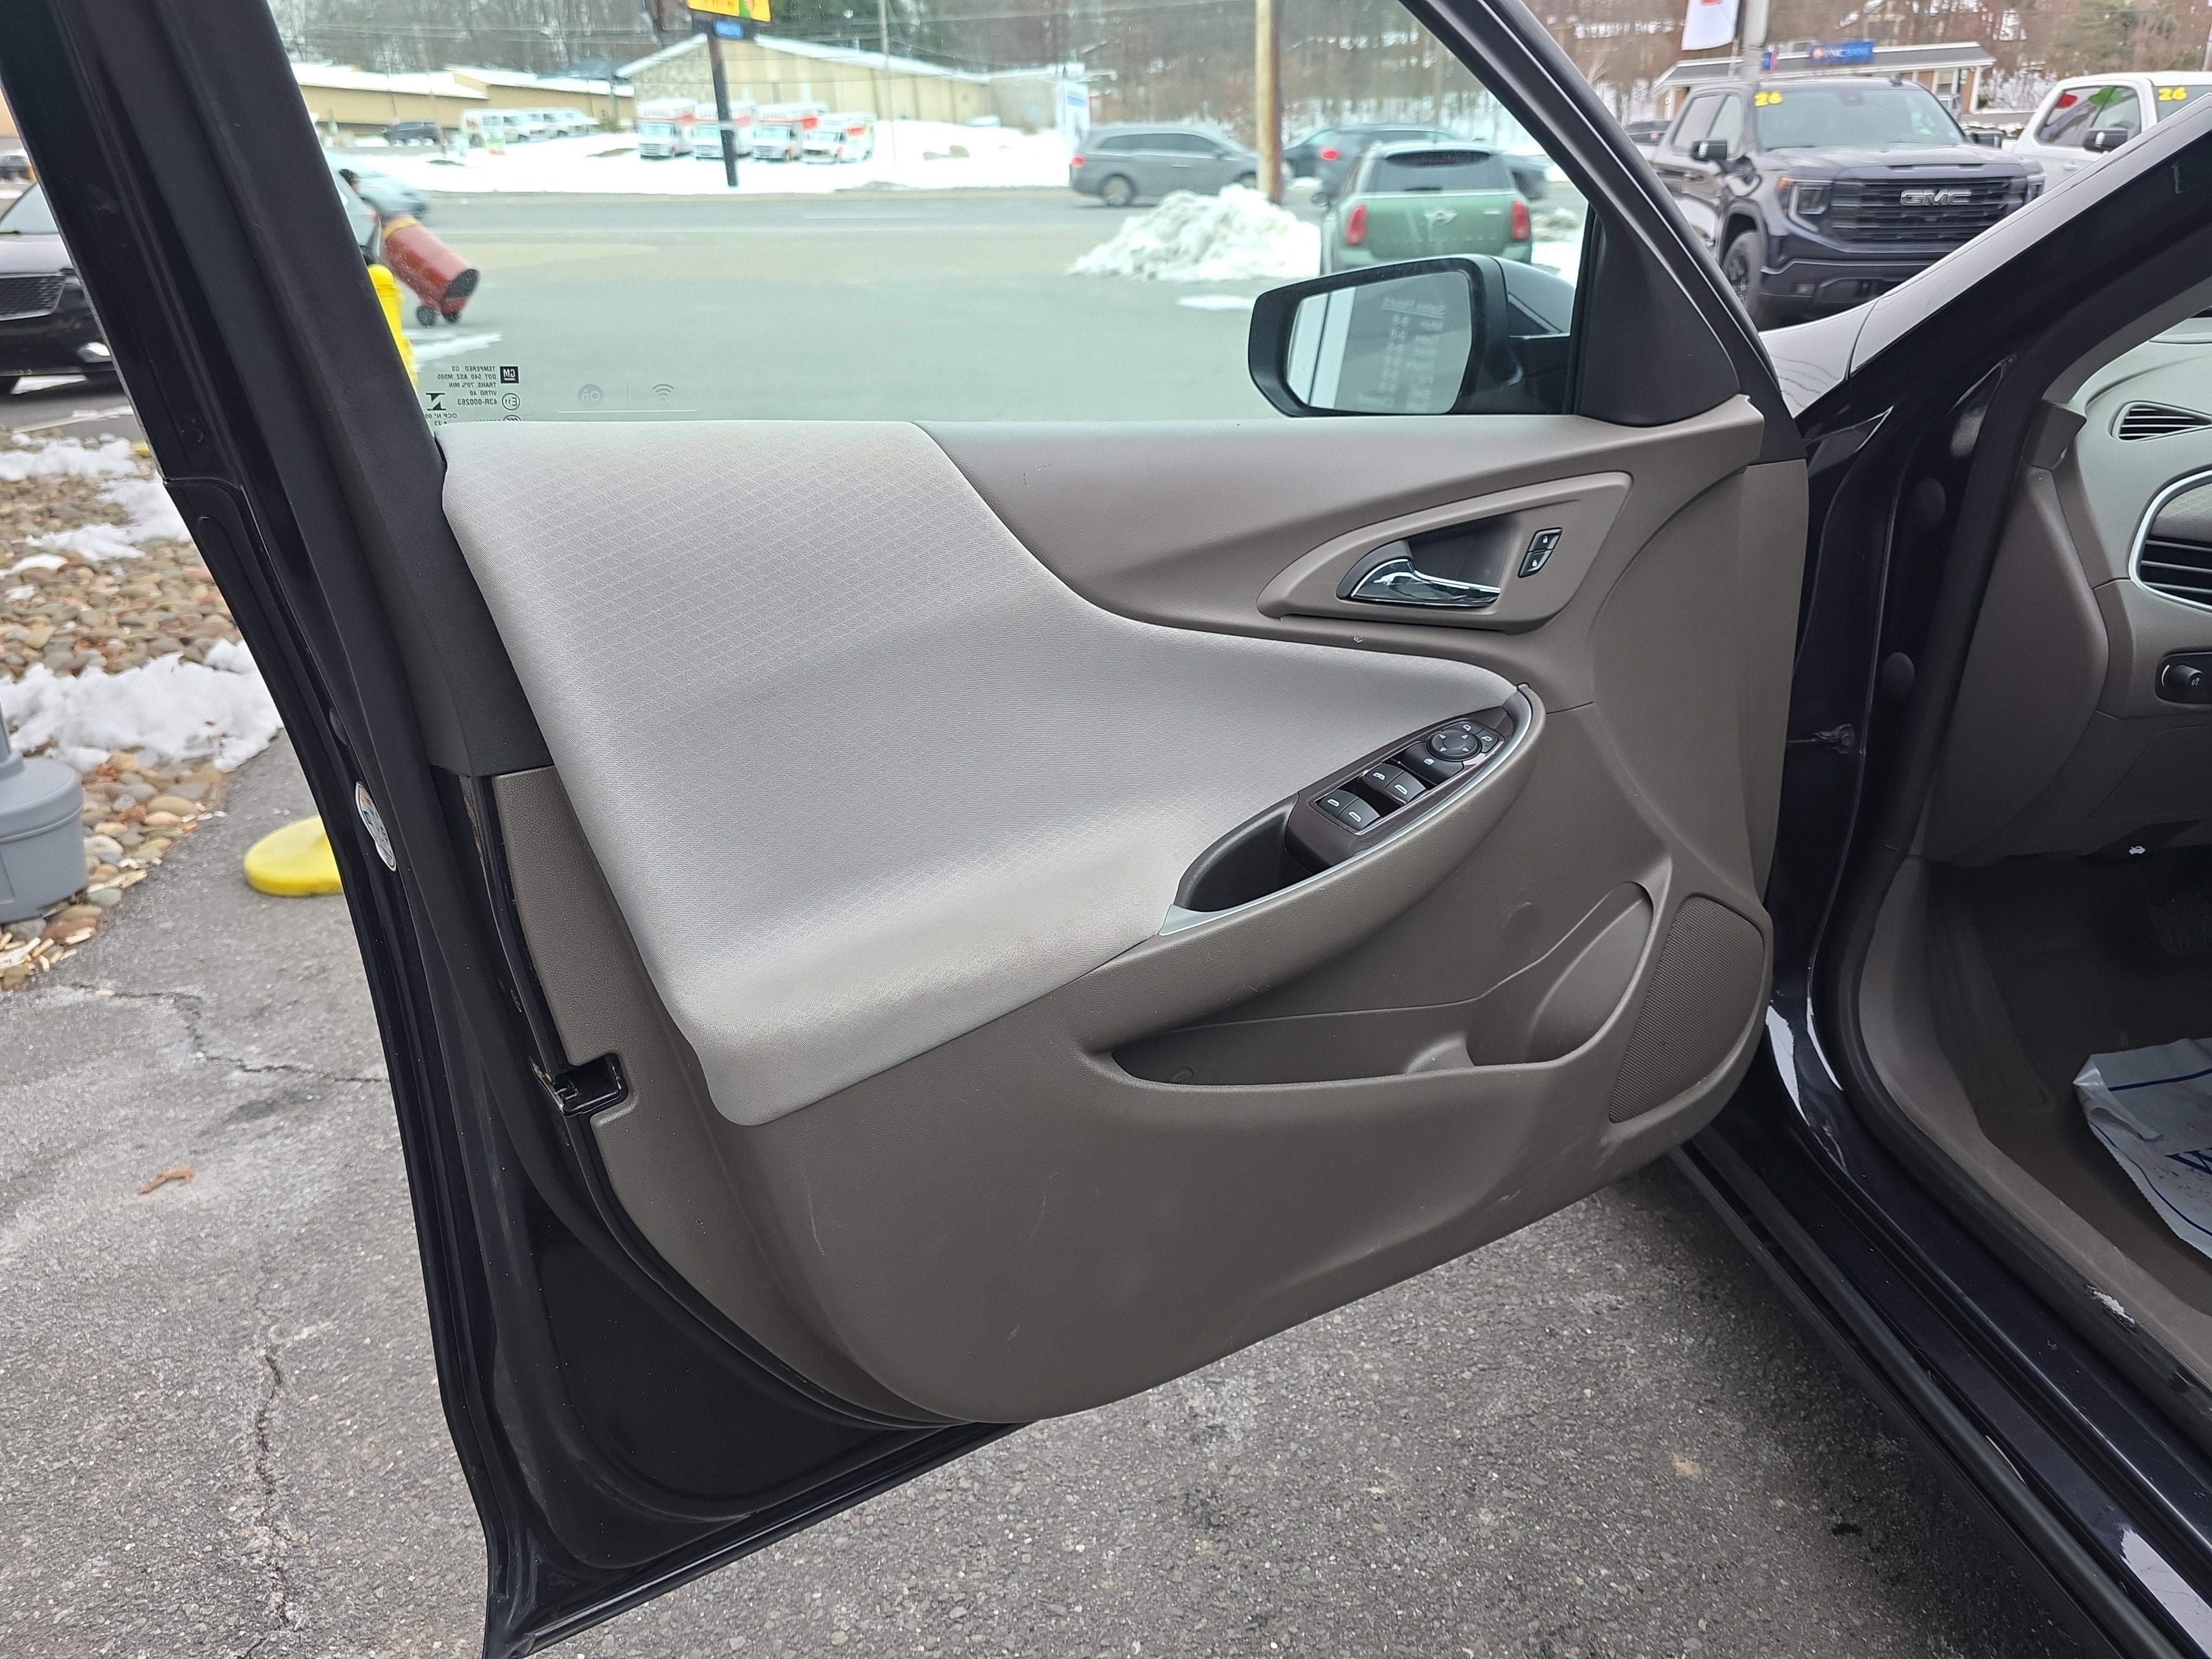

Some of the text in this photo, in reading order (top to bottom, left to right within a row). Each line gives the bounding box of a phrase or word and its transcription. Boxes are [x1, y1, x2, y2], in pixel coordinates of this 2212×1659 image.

[1754, 91, 1783, 107] 26
[2158, 87, 2187, 101] 26
[1900, 189, 1972, 206] GMC
